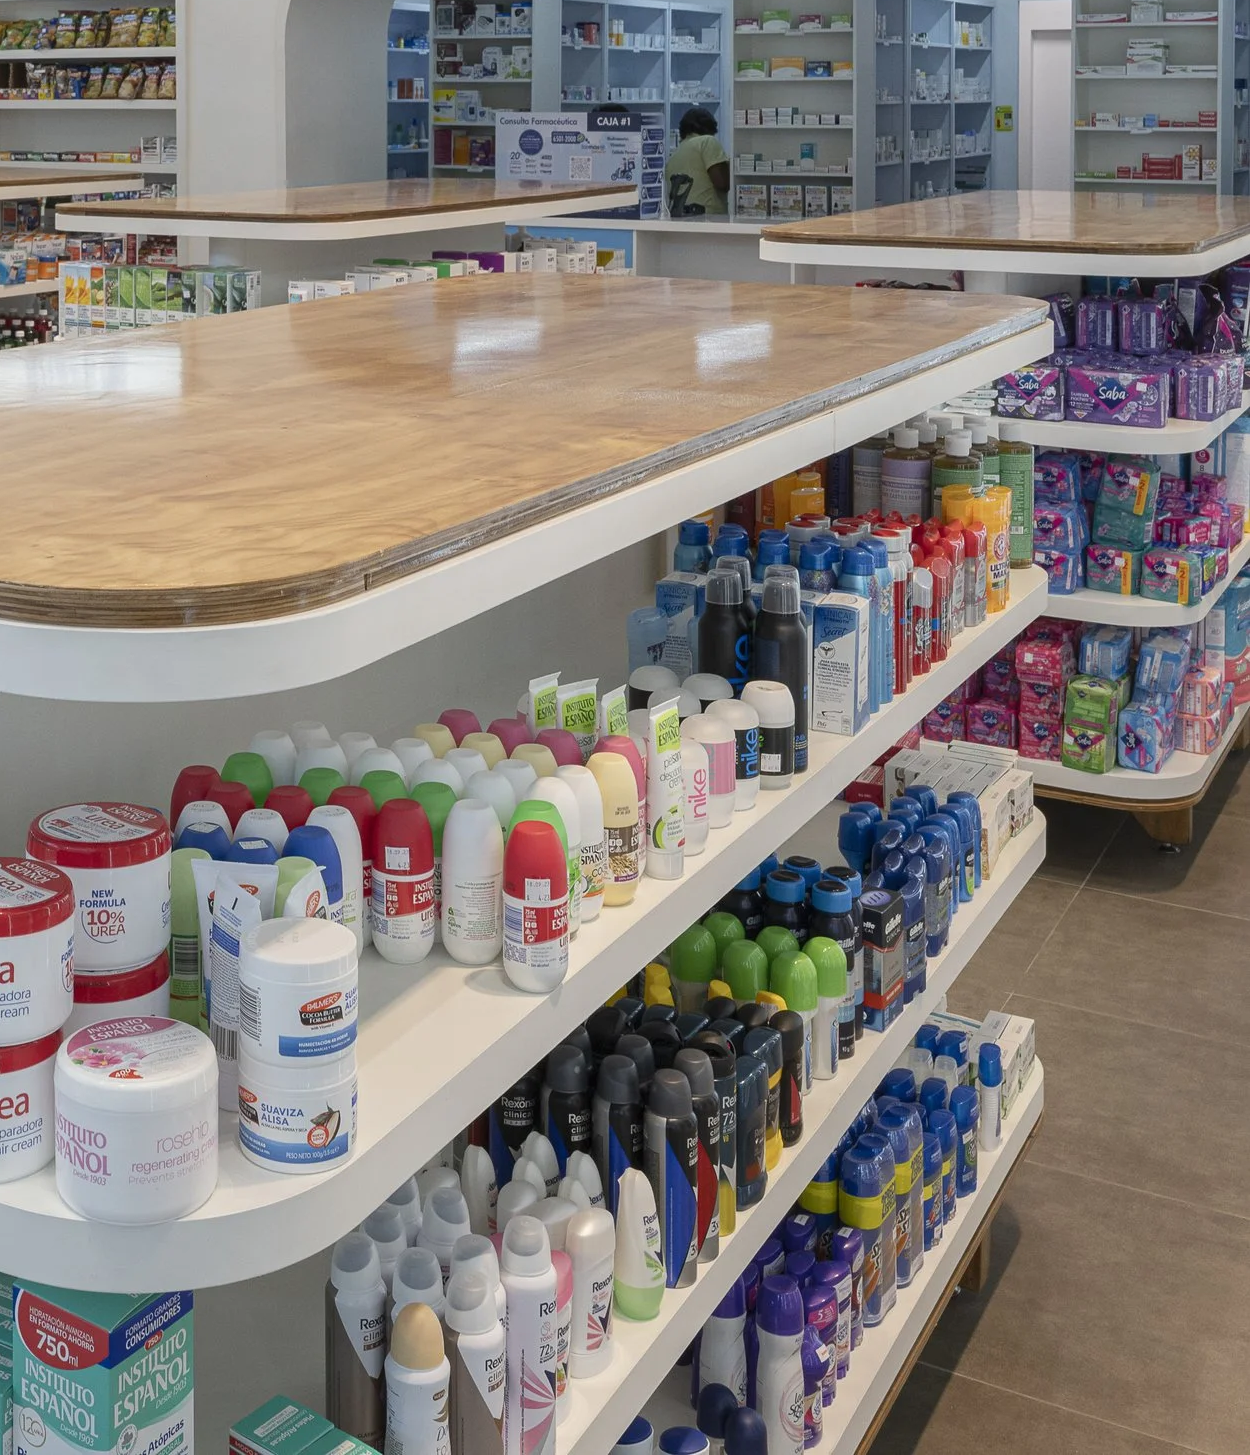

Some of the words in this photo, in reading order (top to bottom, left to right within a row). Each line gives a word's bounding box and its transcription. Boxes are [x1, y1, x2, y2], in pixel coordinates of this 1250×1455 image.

[500, 117, 529, 126] Consulta
[531, 116, 578, 126] Farmacéutica
[597, 117, 619, 126] CAJA
[620, 117, 631, 126] #1
[1019, 379, 1039, 390] Saba
[1099, 386, 1126, 400] Saba
[821, 626, 848, 638] Secret
[566, 698, 594, 712] INSTITUTO
[741, 727, 759, 776] nike
[688, 768, 707, 819] nike
[92, 889, 113, 898] NEW
[80, 898, 126, 908] FORMULA
[87, 909, 125, 926] 10%
[91, 925, 125, 938] UREA
[306, 992, 339, 1012] PALMER'S
[301, 1010, 323, 1020] COCOA
[261, 1103, 304, 1119] SUAVIZA
[261, 1113, 290, 1127] ALISA
[11, 1133, 42, 1152] cream
[157, 1118, 209, 1154] rosehip
[131, 1145, 199, 1174] regenerating
[90, 1174, 107, 1185] 1903
[129, 1171, 175, 1186] Prevents
[125, 1314, 154, 1337] FORMATO
[154, 1292, 181, 1318] GRANDES
[29, 1306, 62, 1330] HIDRATACIÓN
[63, 1320, 94, 1344] AVANZADA
[29, 1315, 37, 1324] EN
[37, 1318, 66, 1340] FORMATO
[67, 1333, 95, 1353] AHORRO
[125, 1302, 181, 1350] CONSUMIDORES
[118, 1328, 187, 1394] INSTITUTO
[25, 1357, 95, 1408] INSTITUTO
[113, 1349, 190, 1428] ESPAÑOL
[21, 1378, 98, 1438] ESPAÑOL
[149, 1418, 184, 1450] Atópicas
